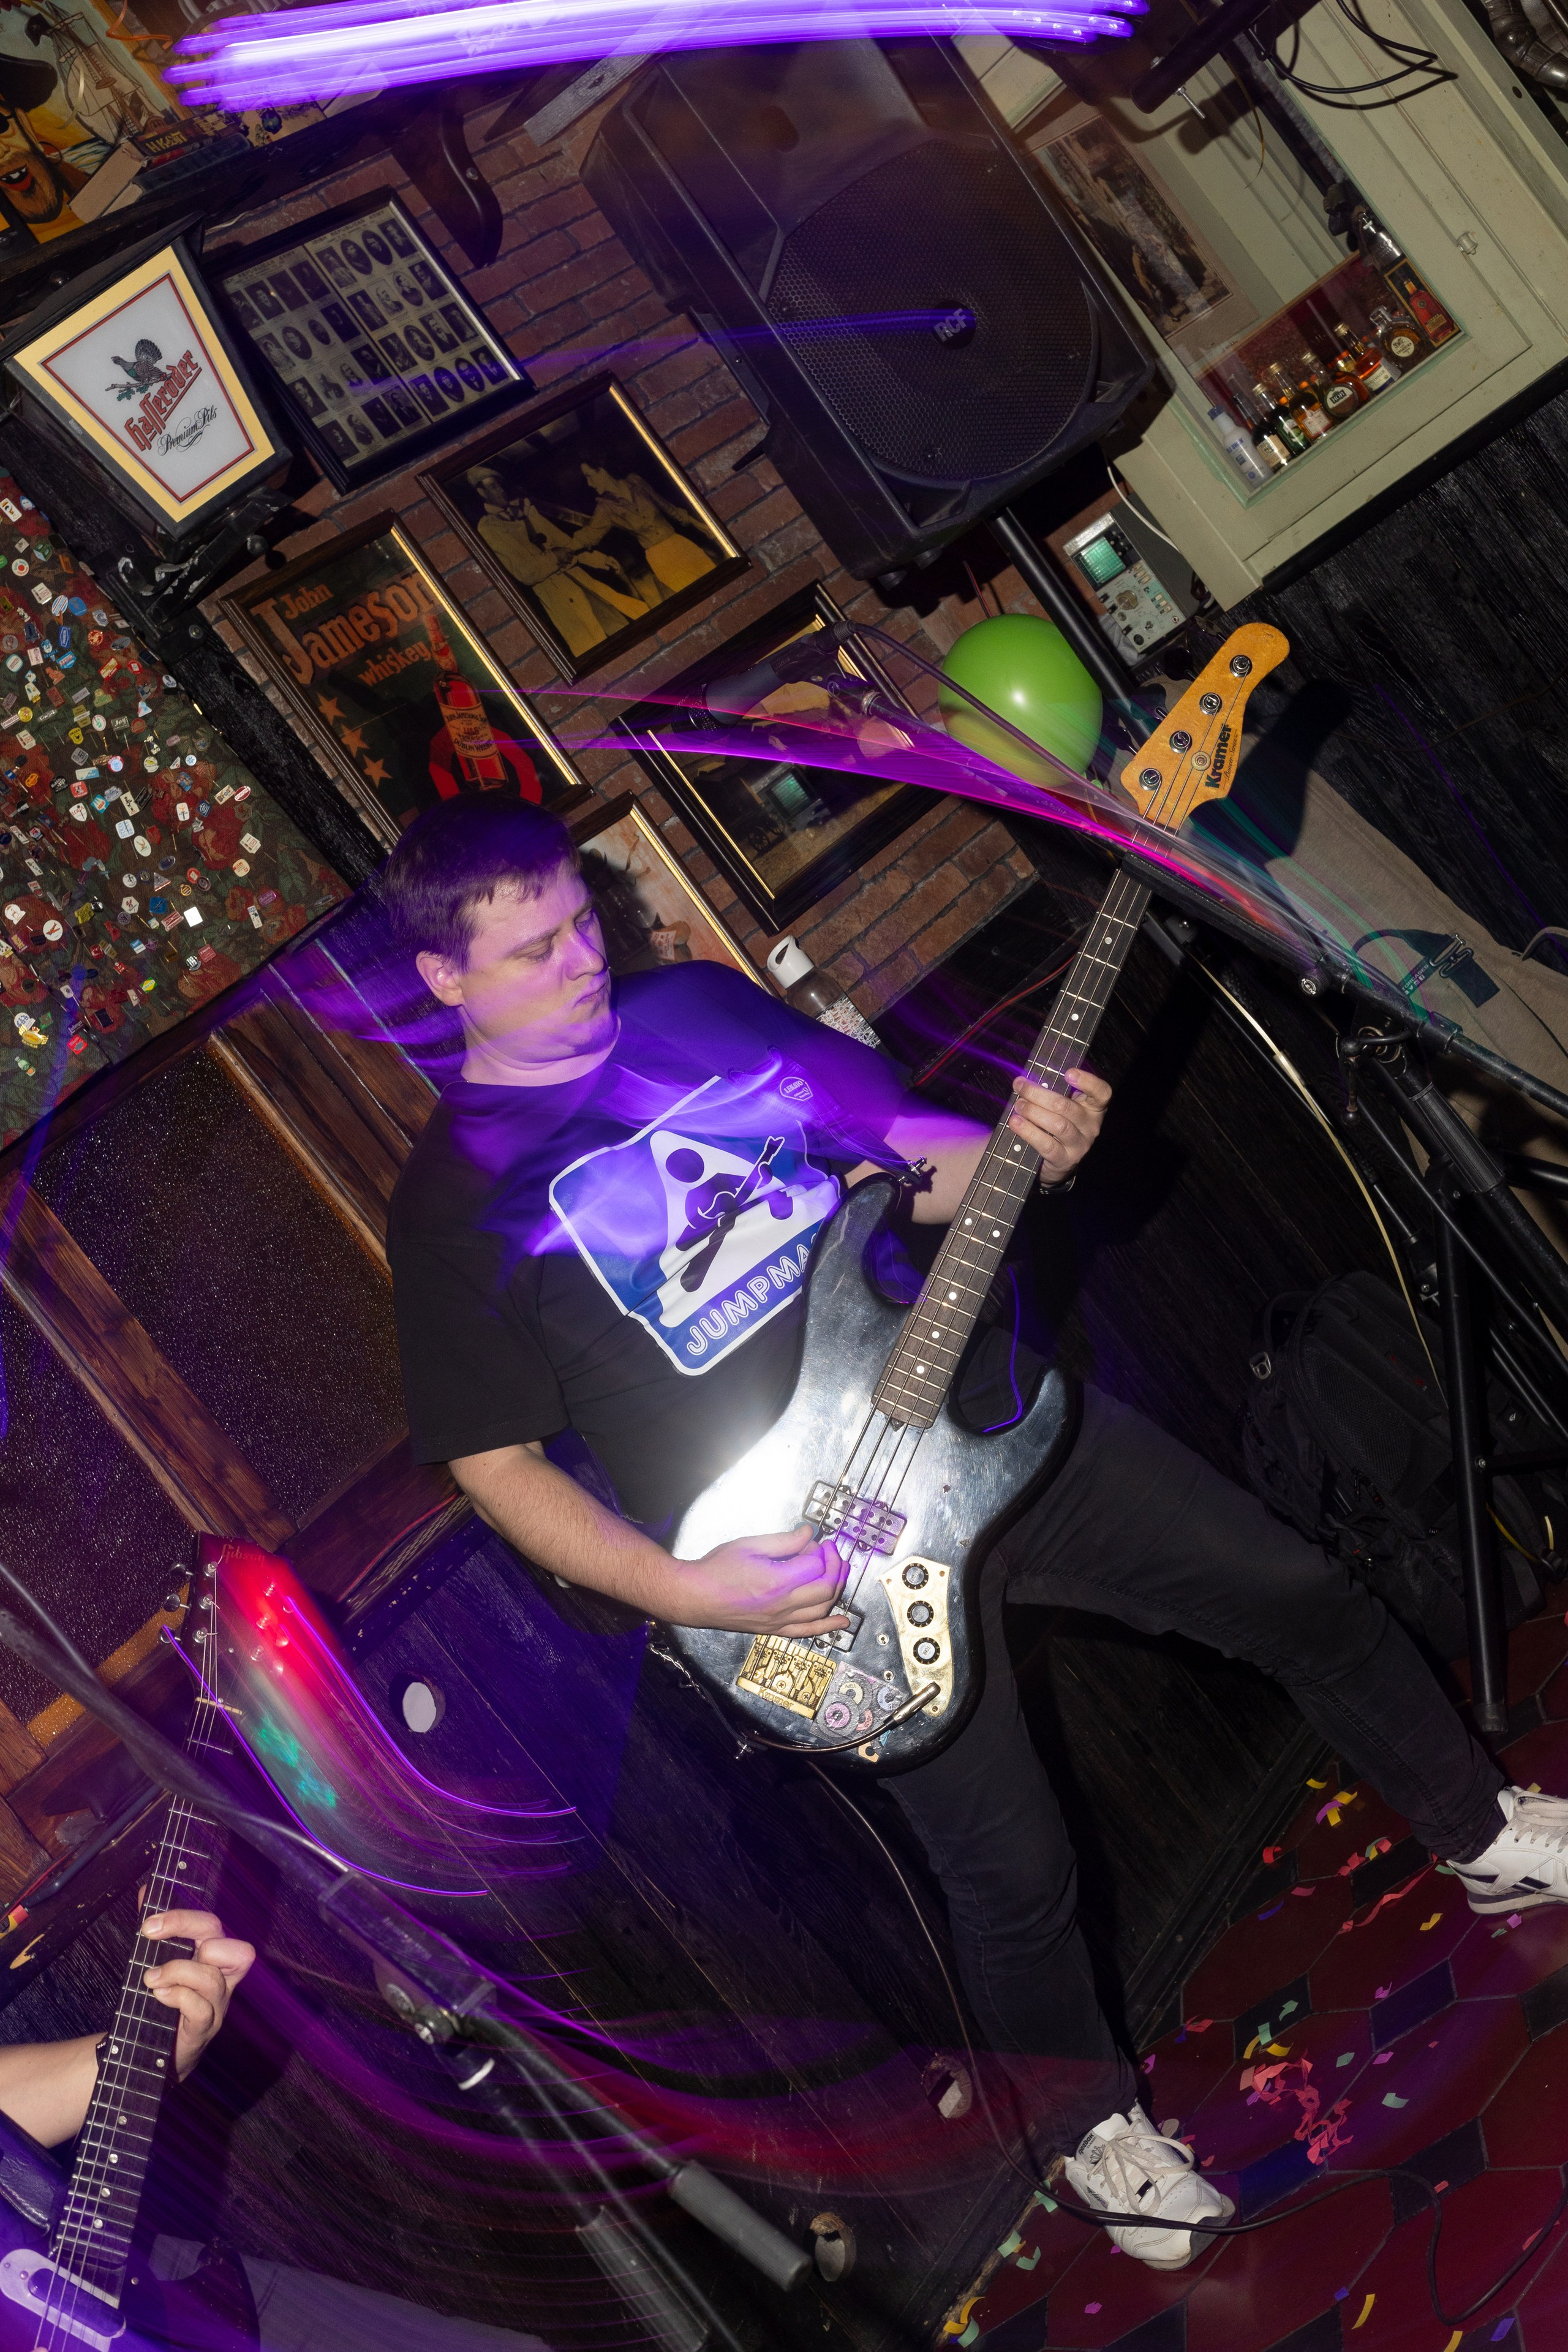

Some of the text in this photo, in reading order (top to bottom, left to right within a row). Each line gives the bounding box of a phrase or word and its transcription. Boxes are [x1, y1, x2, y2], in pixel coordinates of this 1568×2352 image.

[331, 219, 366, 236] REPUBLICAN
[369, 210, 385, 220] ARMY
[933, 308, 967, 341] RCF
[157, 405, 217, 456] Premium Pils
[281, 582, 334, 619] John
[251, 571, 435, 685] Jameson
[358, 639, 430, 687] whiskey
[115, 717, 127, 728] Joy
[1205, 723, 1232, 789] Kramer
[1229, 738, 1238, 756] Series
[217, 788, 231, 802] Bros
[1401, 965, 1429, 991] TORCASES
[783, 1079, 804, 1095] LEKATO
[687, 1236, 815, 1355] JUMPMA
[222, 1544, 265, 1568] Gibson
[922, 1646, 931, 1656] TONE
[758, 1686, 794, 1709] Kramer
